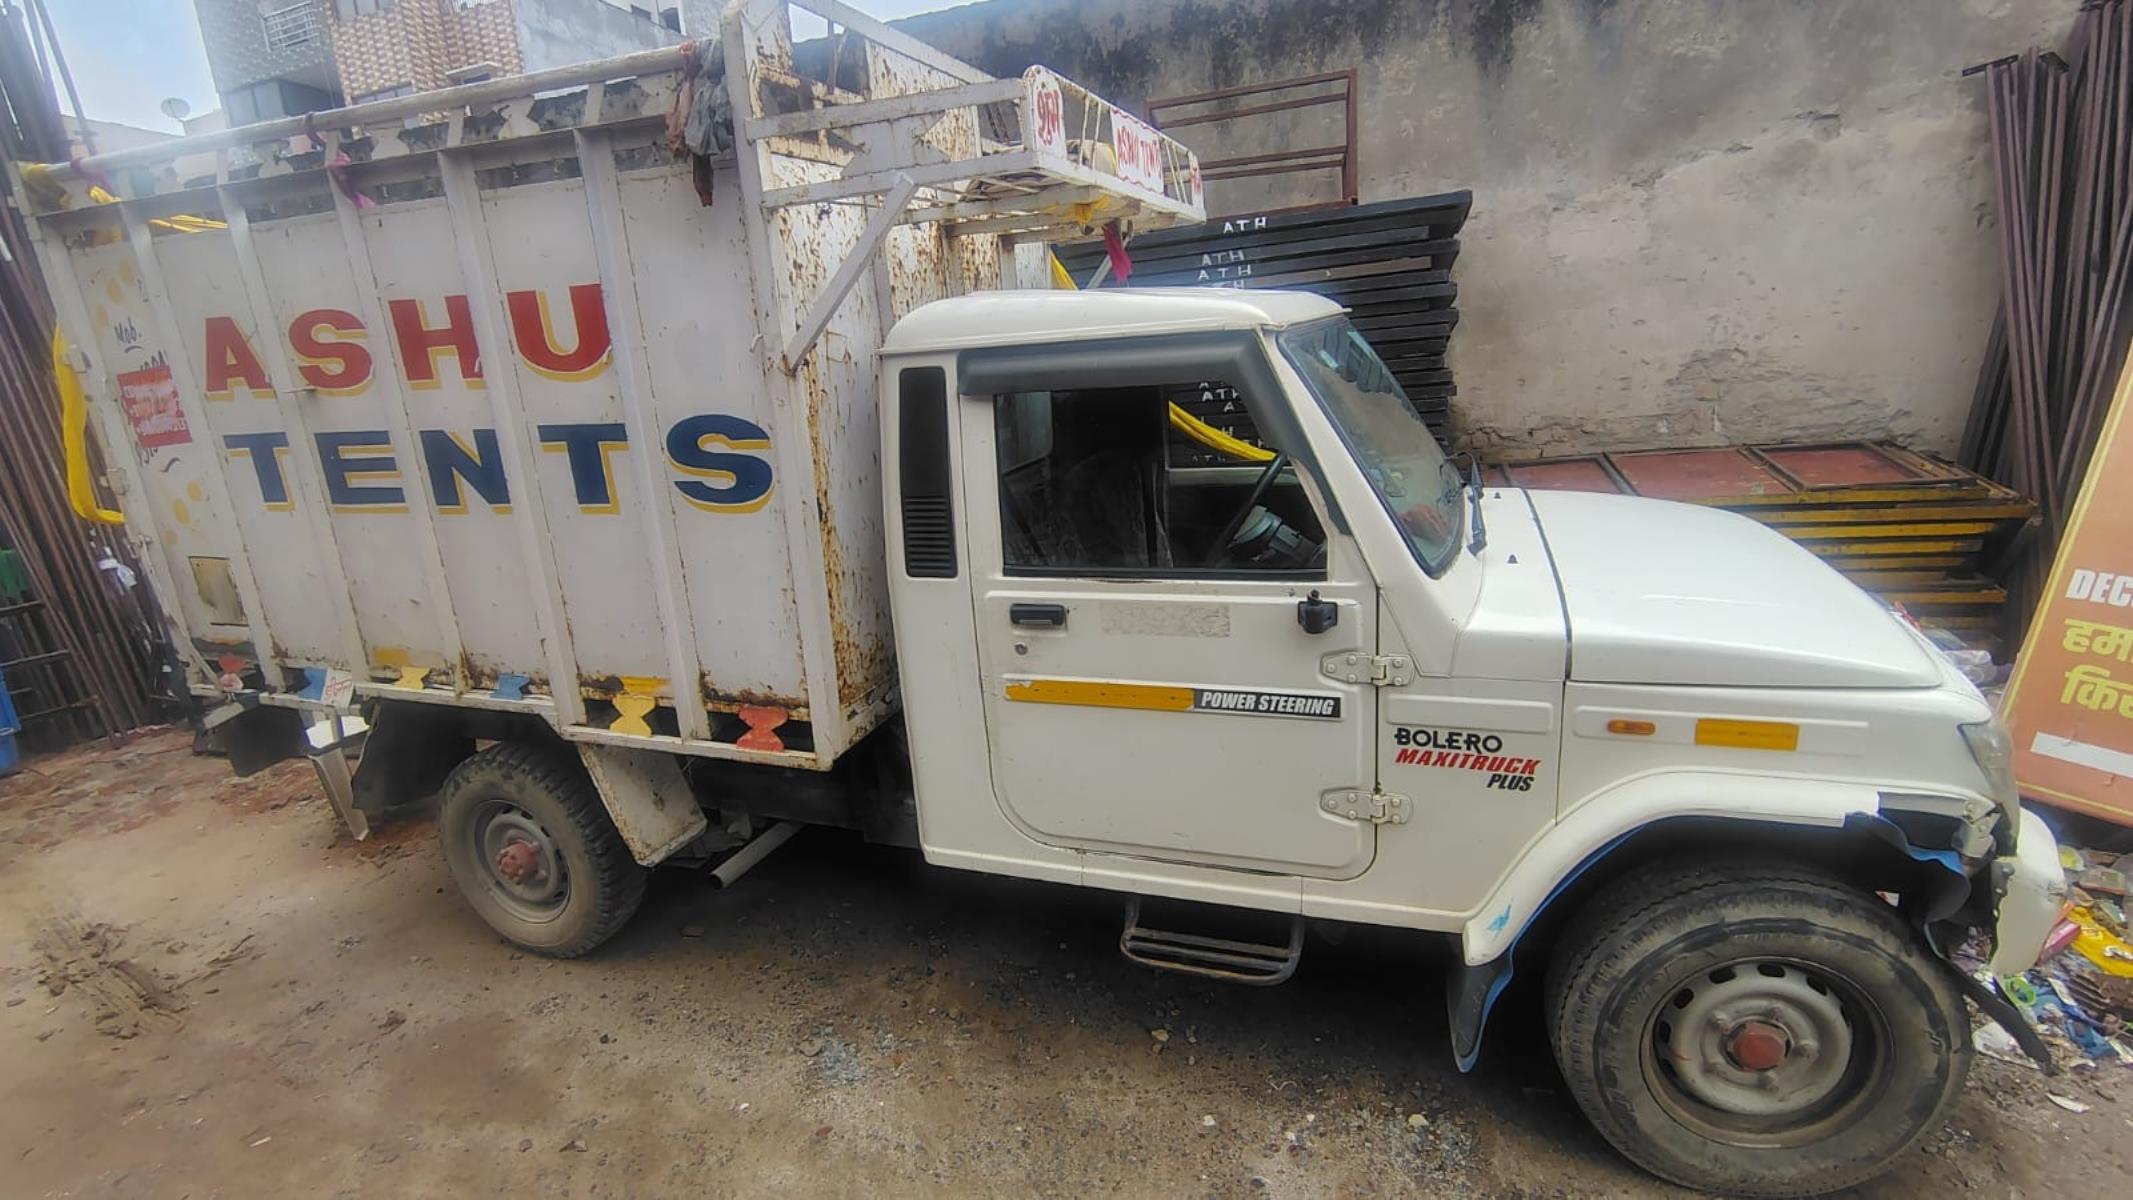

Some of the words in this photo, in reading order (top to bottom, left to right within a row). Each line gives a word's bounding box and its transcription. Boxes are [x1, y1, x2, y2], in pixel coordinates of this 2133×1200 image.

[1223, 216, 1267, 234] ATH
[1201, 250, 1245, 266] ATH
[1198, 264, 1252, 281] ATH
[205, 283, 612, 400] ASHU
[223, 414, 774, 515] TENTS
[2065, 568, 2133, 608] DEC
[1201, 691, 1257, 710] POWER
[1258, 694, 1335, 716] STEERING
[1394, 727, 1504, 754] BOLERO
[1395, 748, 1542, 776] MAXITRUCK
[1486, 773, 1535, 792] PLUS
